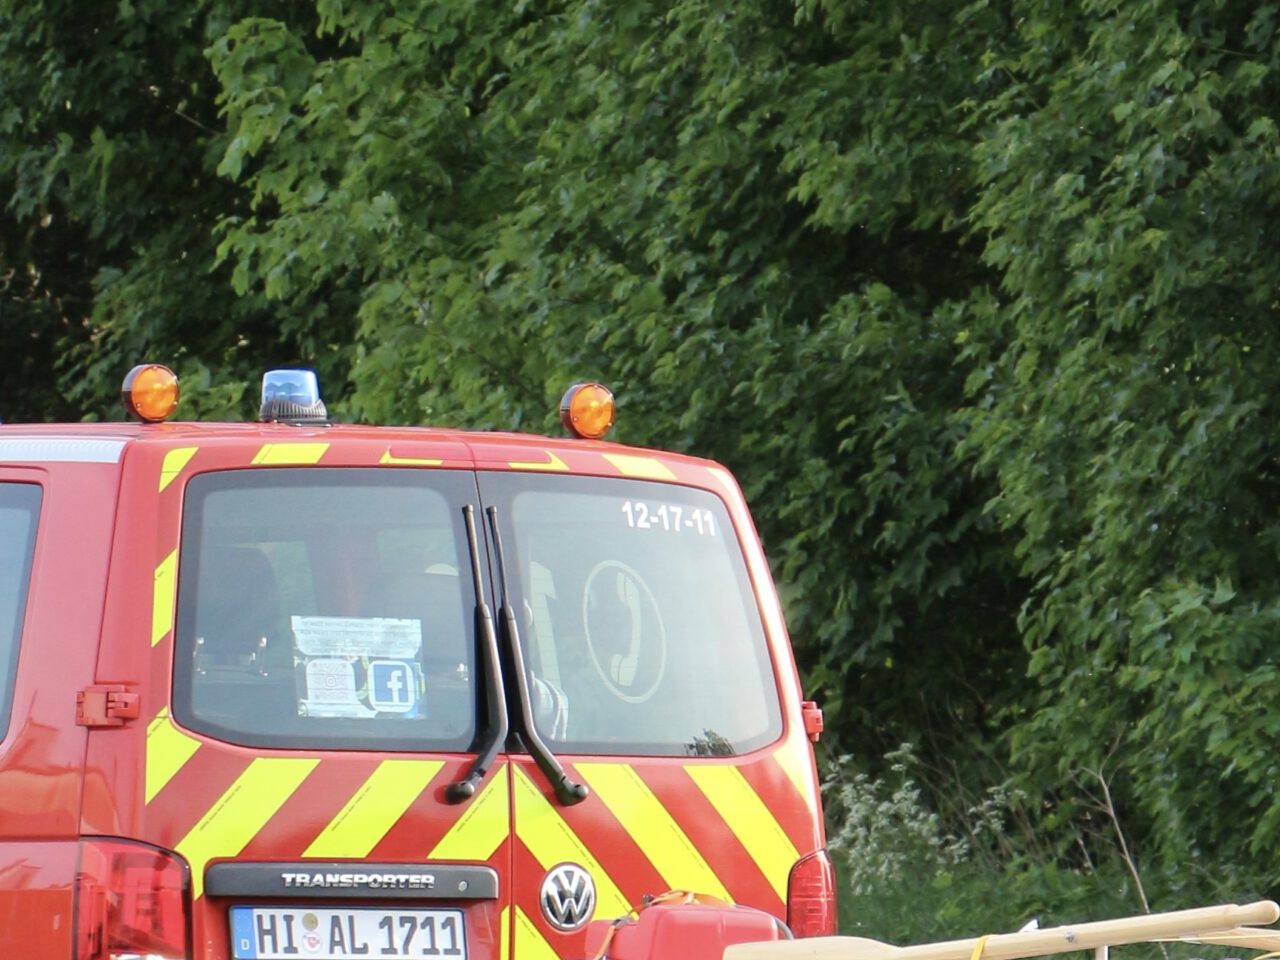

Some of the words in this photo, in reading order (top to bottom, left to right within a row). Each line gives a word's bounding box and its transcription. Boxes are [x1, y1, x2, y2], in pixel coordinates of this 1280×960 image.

[621, 501, 716, 537] 12-17-11
[281, 873, 436, 889] TRANSPORTER
[256, 914, 298, 954] HI
[329, 915, 369, 955] AL
[378, 916, 462, 956] 1711
